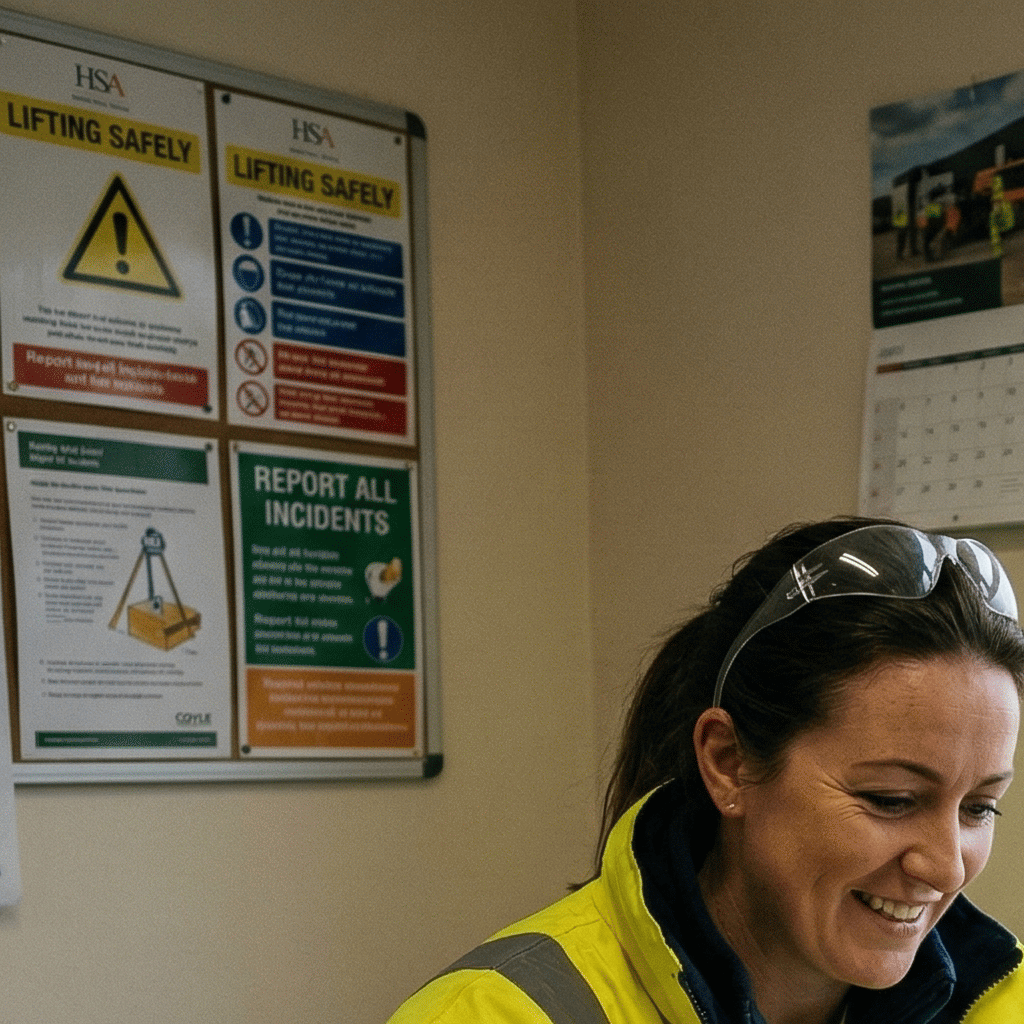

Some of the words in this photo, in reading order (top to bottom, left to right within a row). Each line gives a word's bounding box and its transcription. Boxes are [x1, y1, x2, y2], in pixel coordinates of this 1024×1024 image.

[75, 63, 125, 97] HSA
[7, 102, 101, 145] LIFTING
[109, 124, 192, 163] SAFELY
[292, 118, 335, 149] HSA
[233, 153, 315, 193] LIFTING
[320, 173, 394, 210] SAFELY
[254, 465, 349, 499] REPORT
[354, 476, 397, 504] ALL
[265, 499, 390, 536] INCIDENTS
